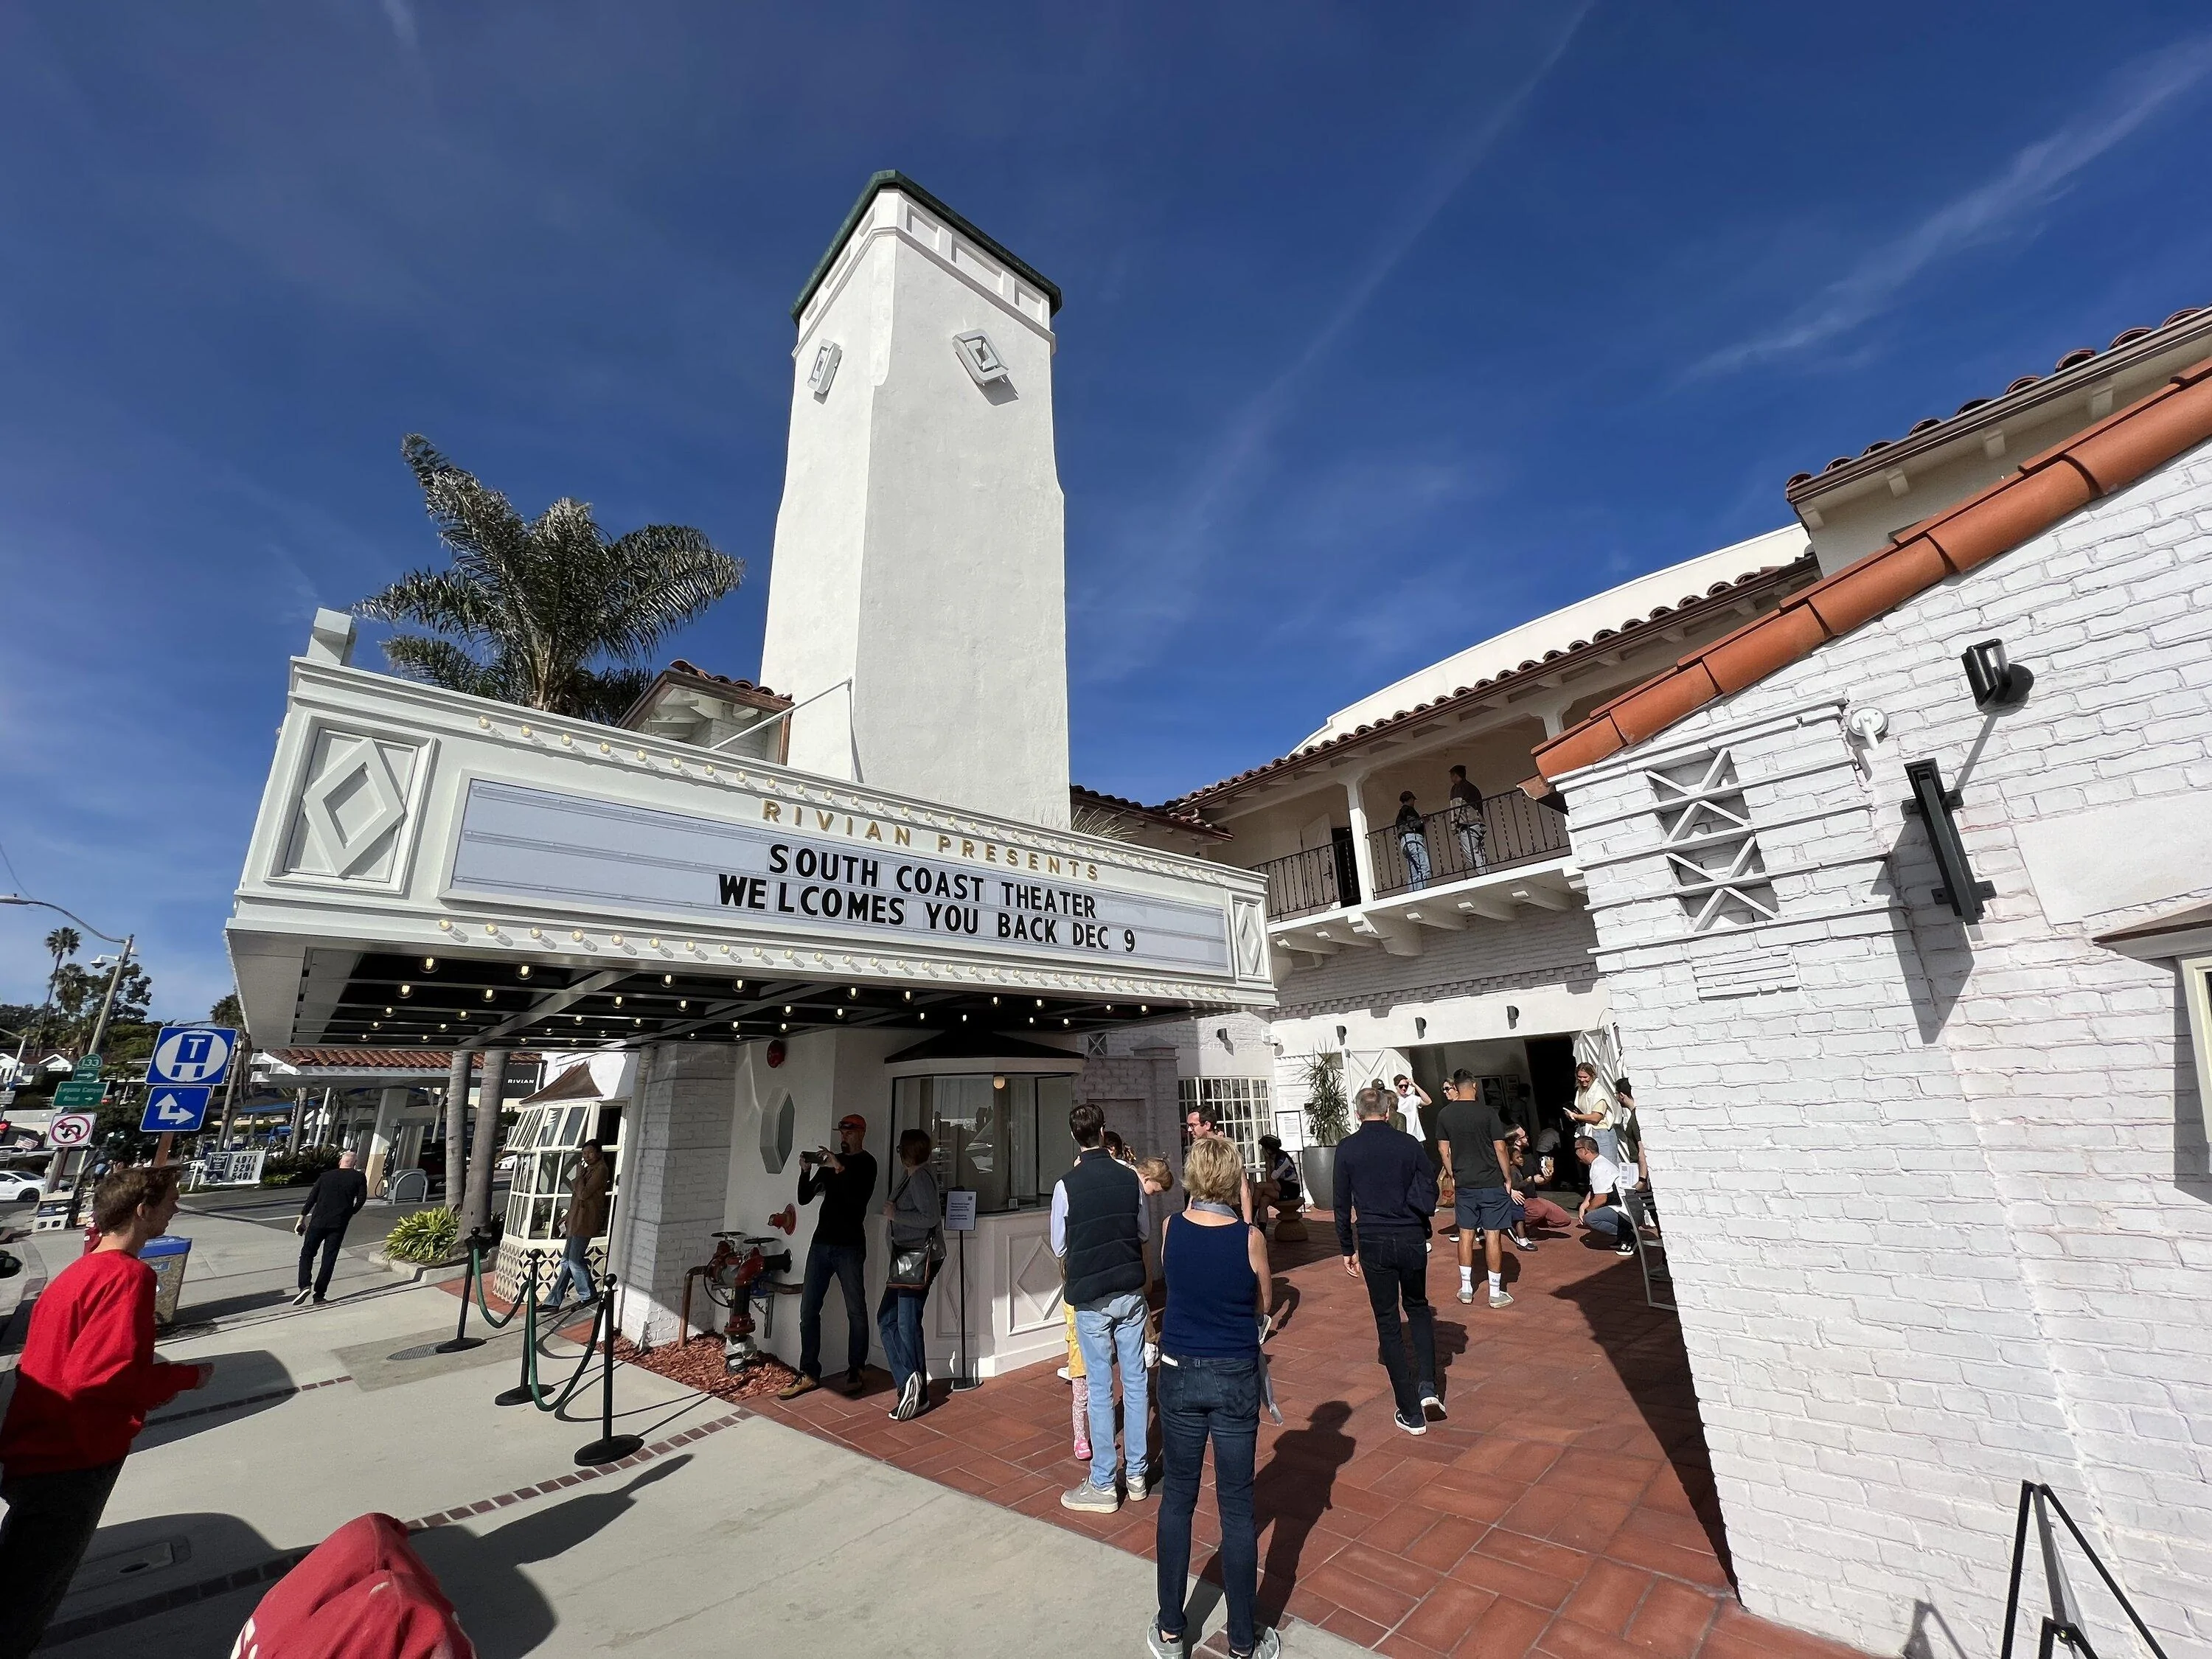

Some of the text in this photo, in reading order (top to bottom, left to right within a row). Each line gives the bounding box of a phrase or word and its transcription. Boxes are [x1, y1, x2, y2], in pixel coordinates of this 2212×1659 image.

[762, 798, 1099, 881] RIVIAN PRESENTS
[718, 873, 1135, 953] WELCOMES YOU BACK DEC 9
[769, 844, 1096, 919] SOUTH COAST THEATER
[81, 1059, 100, 1067] 133
[188, 1038, 206, 1059] T
